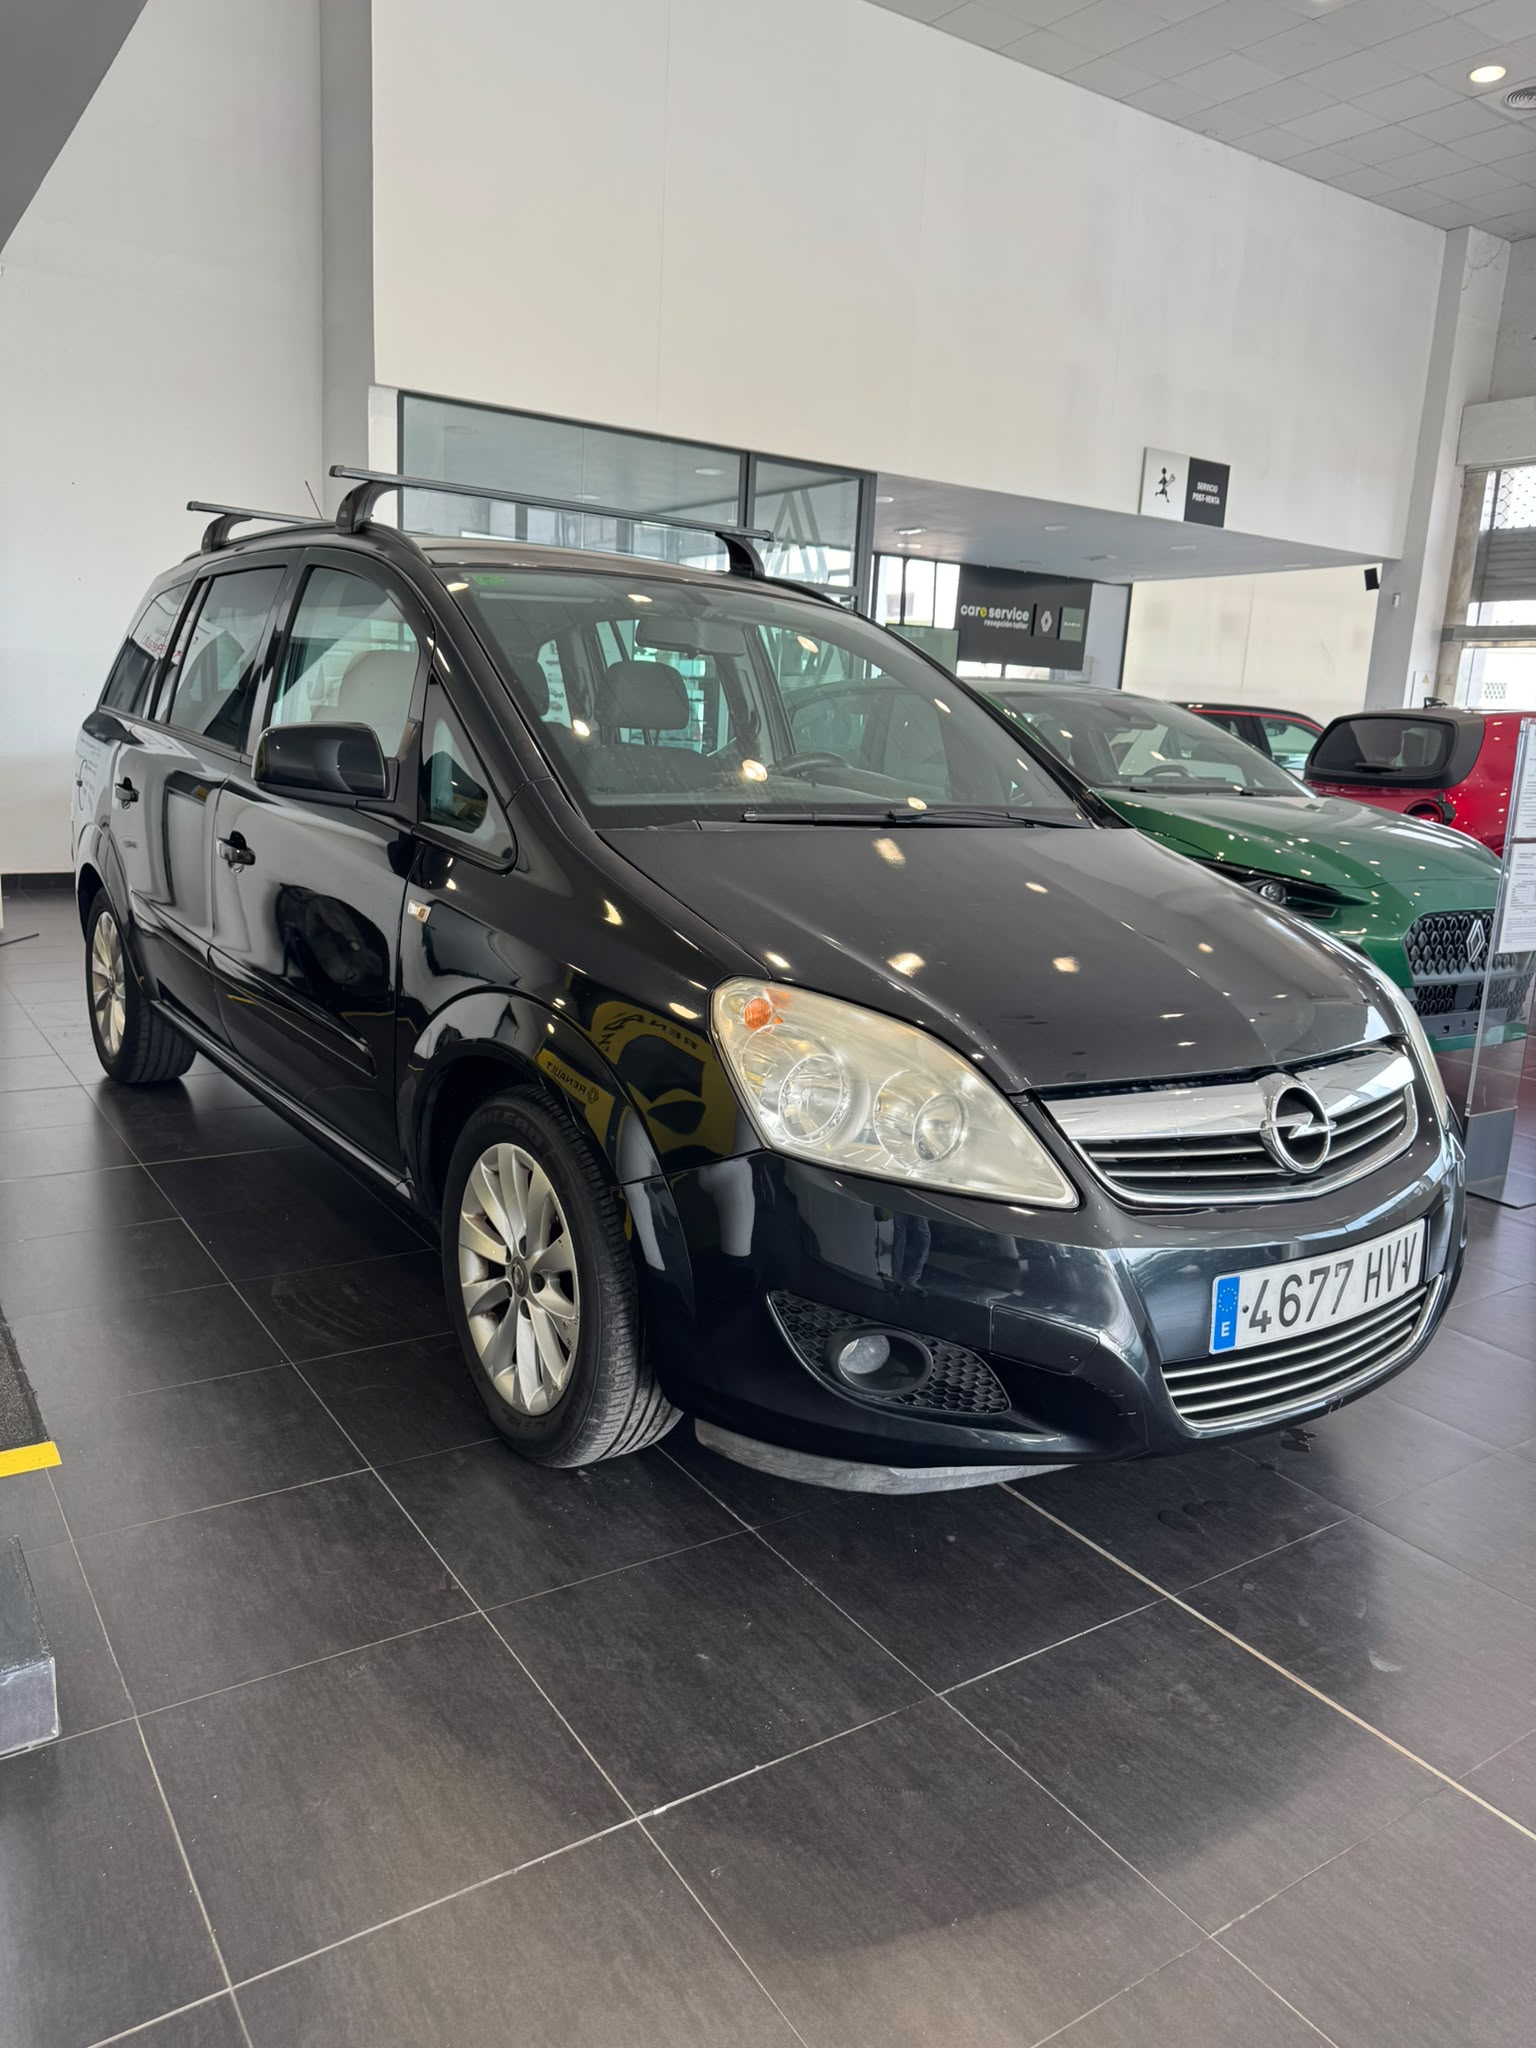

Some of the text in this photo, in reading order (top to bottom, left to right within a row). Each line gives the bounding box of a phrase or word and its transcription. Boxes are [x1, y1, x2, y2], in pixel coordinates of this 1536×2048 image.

[989, 606, 1030, 622] service
[1248, 1231, 1418, 1334] 4677 HVV
[1220, 1320, 1231, 1338] E
